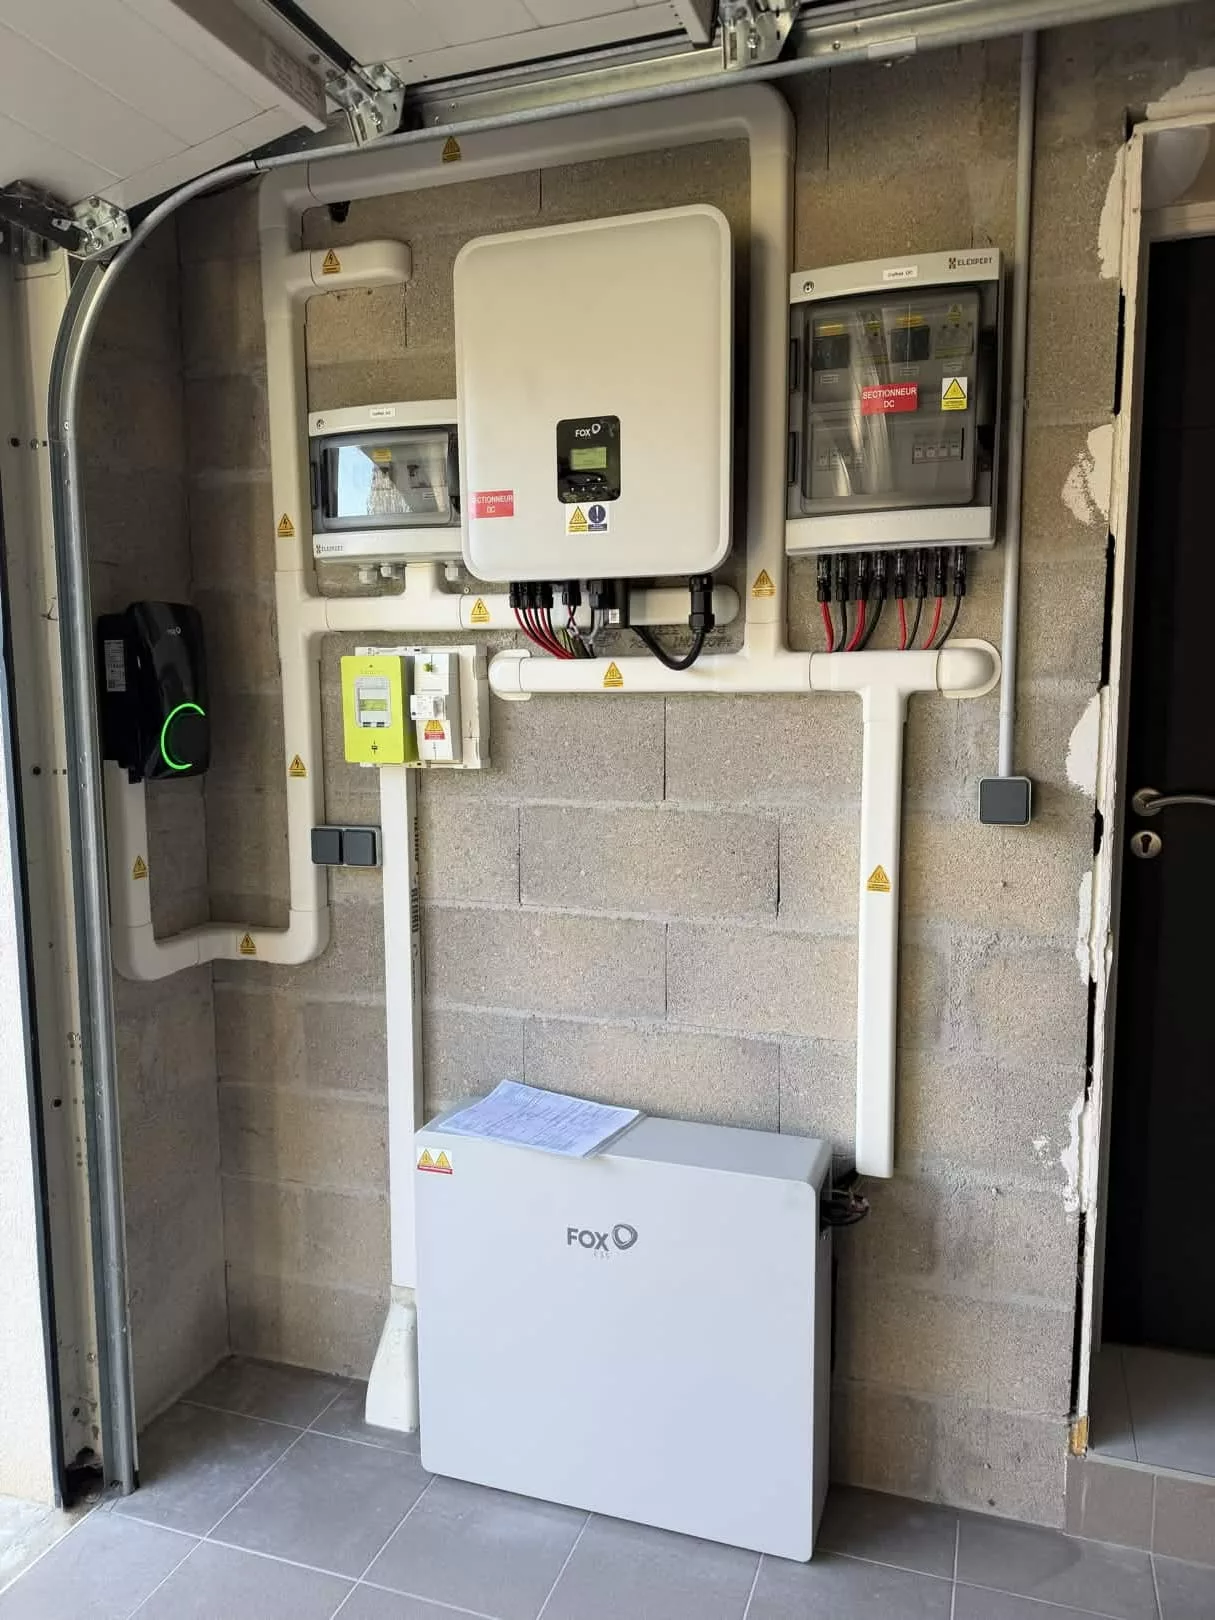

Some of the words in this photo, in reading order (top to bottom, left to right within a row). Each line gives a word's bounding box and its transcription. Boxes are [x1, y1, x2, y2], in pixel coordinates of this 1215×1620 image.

[863, 387, 917, 399] SECTIONNEUR
[883, 400, 895, 408] DC
[575, 429, 591, 437] FOX
[567, 1227, 609, 1251] FOX
